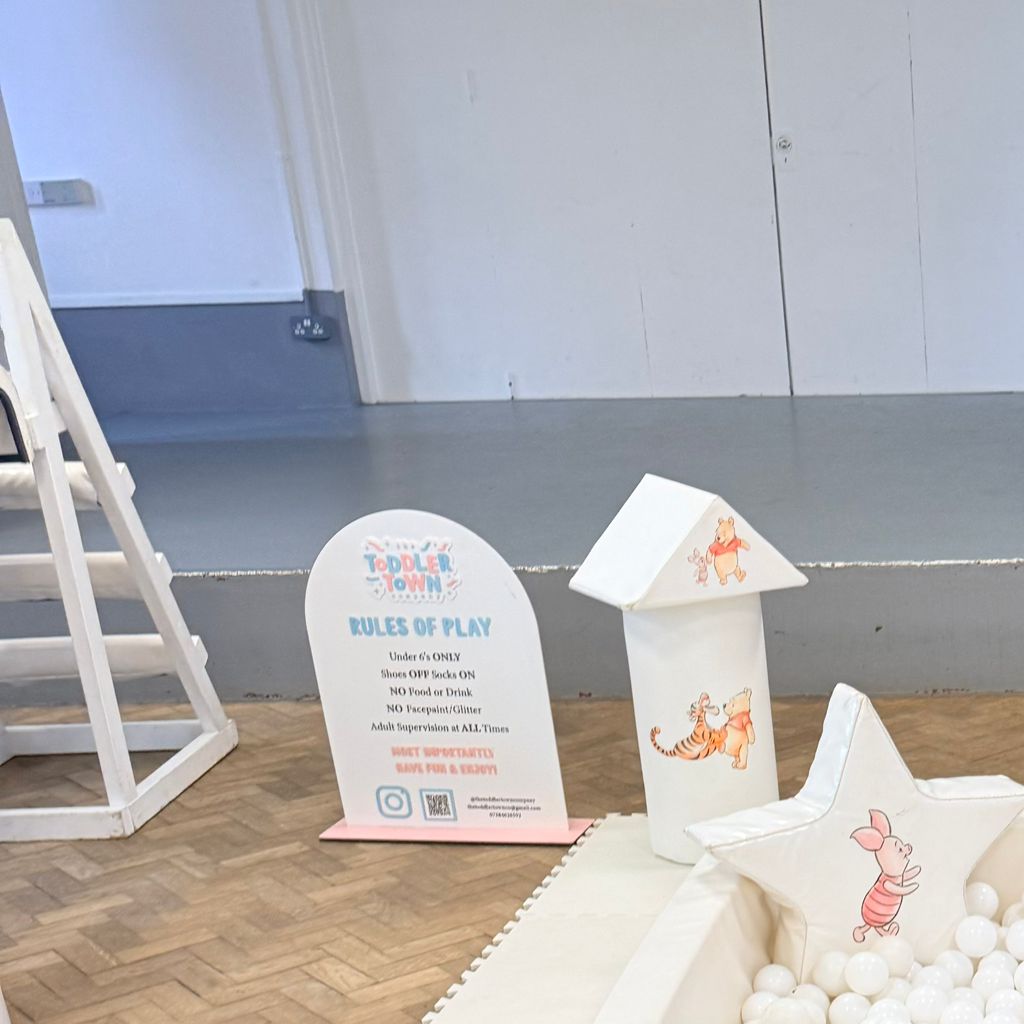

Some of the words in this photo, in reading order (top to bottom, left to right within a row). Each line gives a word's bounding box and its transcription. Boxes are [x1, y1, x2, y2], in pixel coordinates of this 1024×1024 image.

[363, 552, 453, 575] TODDLER
[383, 573, 442, 593] TOWN
[349, 616, 409, 637] RULES
[413, 616, 437, 637] OF
[442, 617, 492, 638] PLAY
[389, 651, 417, 662] Under
[419, 651, 431, 662] 6's
[432, 651, 461, 662] ONLY
[380, 669, 407, 680] Shoes
[408, 669, 430, 680] OFF
[431, 669, 457, 680] Socks
[458, 669, 476, 680] ON
[389, 686, 407, 697] NO
[408, 686, 432, 697] Food
[433, 689, 444, 697] or
[445, 687, 473, 698] Drink
[386, 703, 403, 714] NO
[406, 704, 482, 716] Facepaint/Glitter
[371, 721, 396, 733] Adult
[397, 722, 450, 735] Supervision
[451, 723, 461, 733] at
[461, 723, 481, 734] ALL
[481, 723, 510, 735] Times
